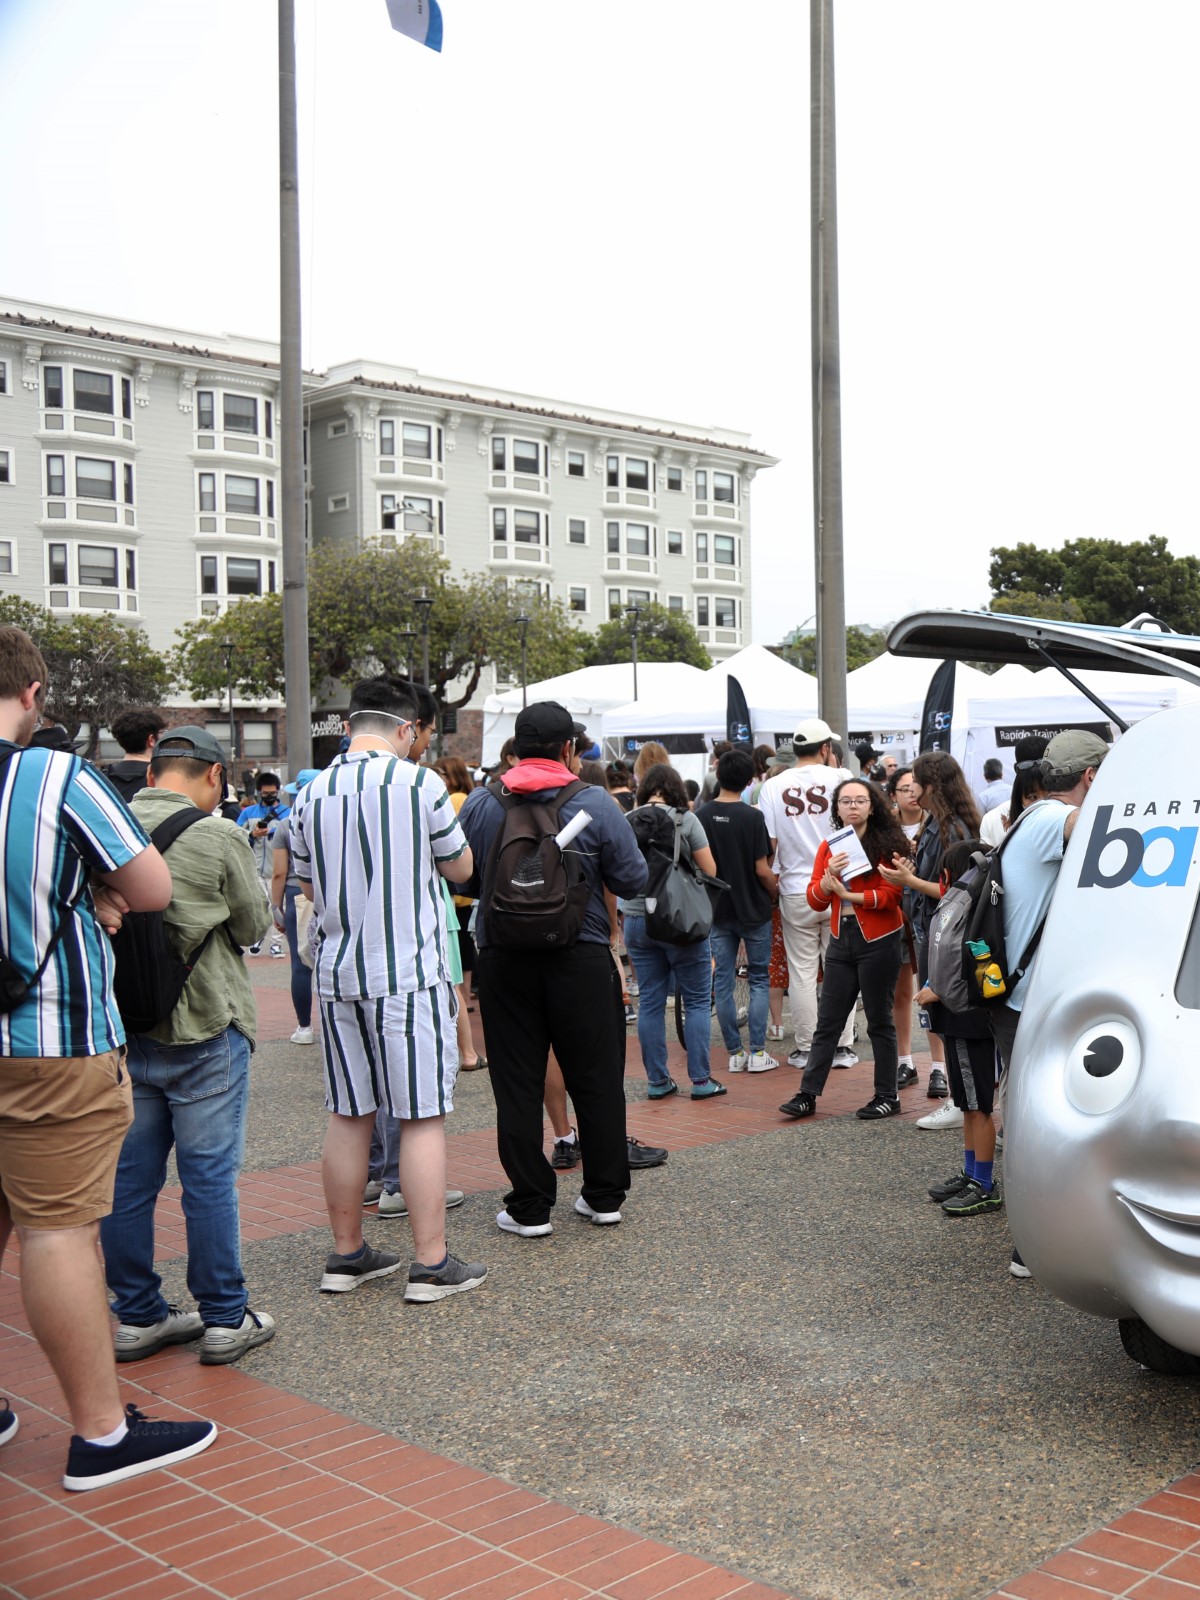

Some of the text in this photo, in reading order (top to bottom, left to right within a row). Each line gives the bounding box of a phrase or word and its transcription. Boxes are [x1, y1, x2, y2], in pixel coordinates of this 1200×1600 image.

[1000, 729, 1031, 742] Rapido
[782, 785, 829, 817] SS
[1077, 805, 1199, 889] ba
